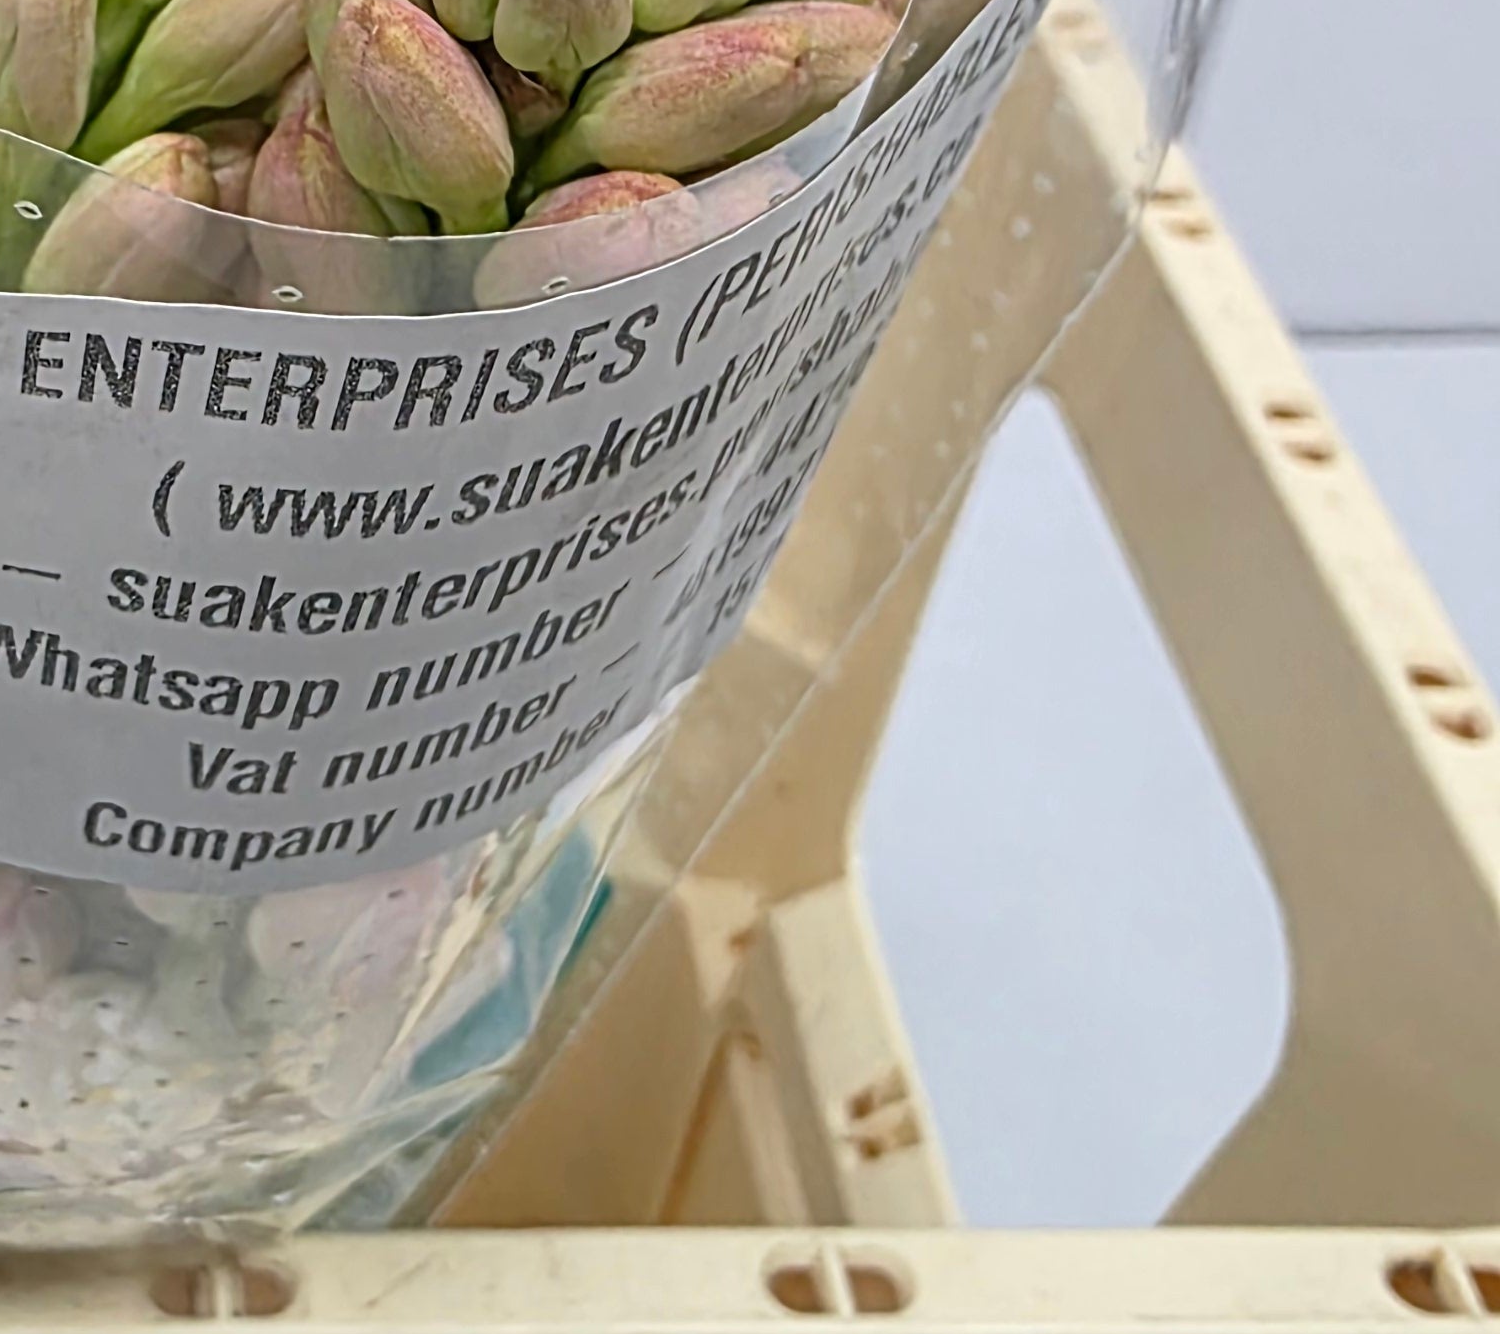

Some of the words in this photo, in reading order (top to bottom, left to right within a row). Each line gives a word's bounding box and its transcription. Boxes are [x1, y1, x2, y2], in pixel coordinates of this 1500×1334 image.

[19, 303, 660, 432] ENTERPRISES
[366, 578, 632, 713] number
[82, 800, 397, 871] Company
[414, 687, 633, 832] number
[187, 741, 297, 796] Vat
[322, 674, 578, 790] number
